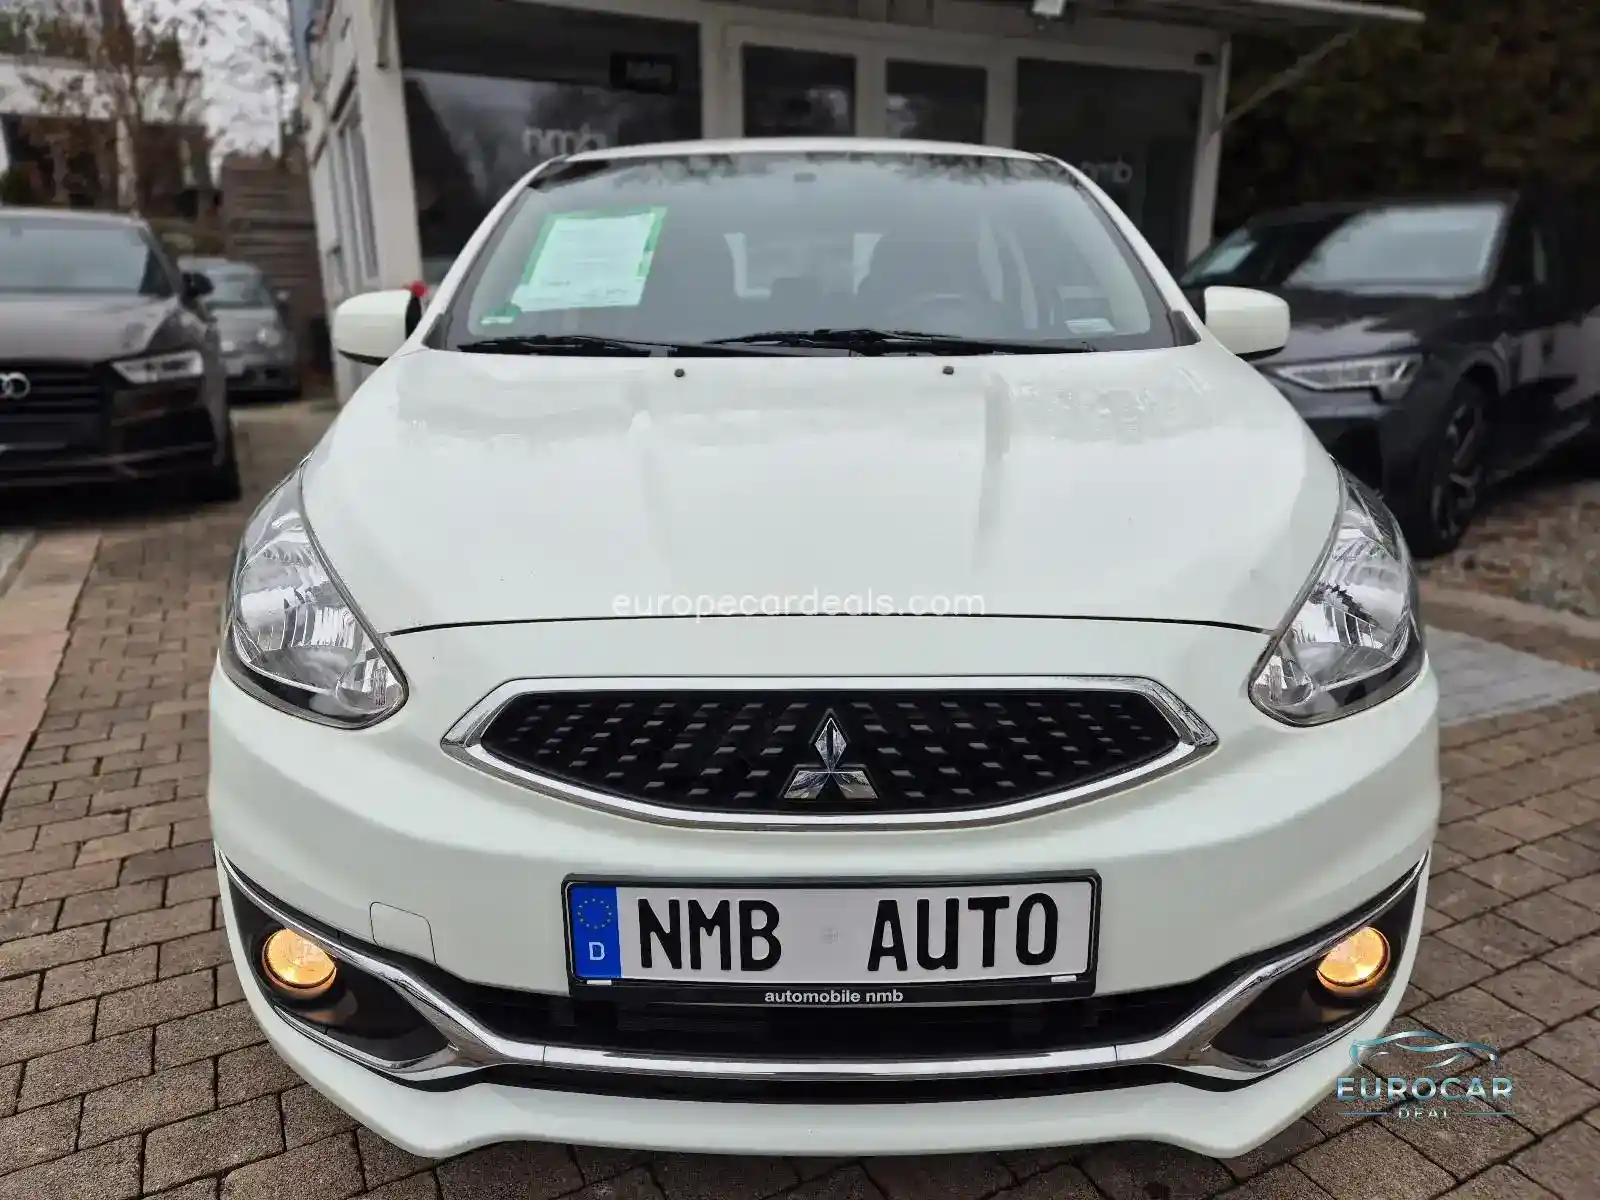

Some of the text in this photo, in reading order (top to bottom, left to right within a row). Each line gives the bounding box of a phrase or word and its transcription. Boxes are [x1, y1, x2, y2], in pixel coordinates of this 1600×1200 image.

[637, 892, 1059, 972] NMB AUTO
[588, 941, 606, 961] D
[765, 988, 904, 1003] automobile nmb
